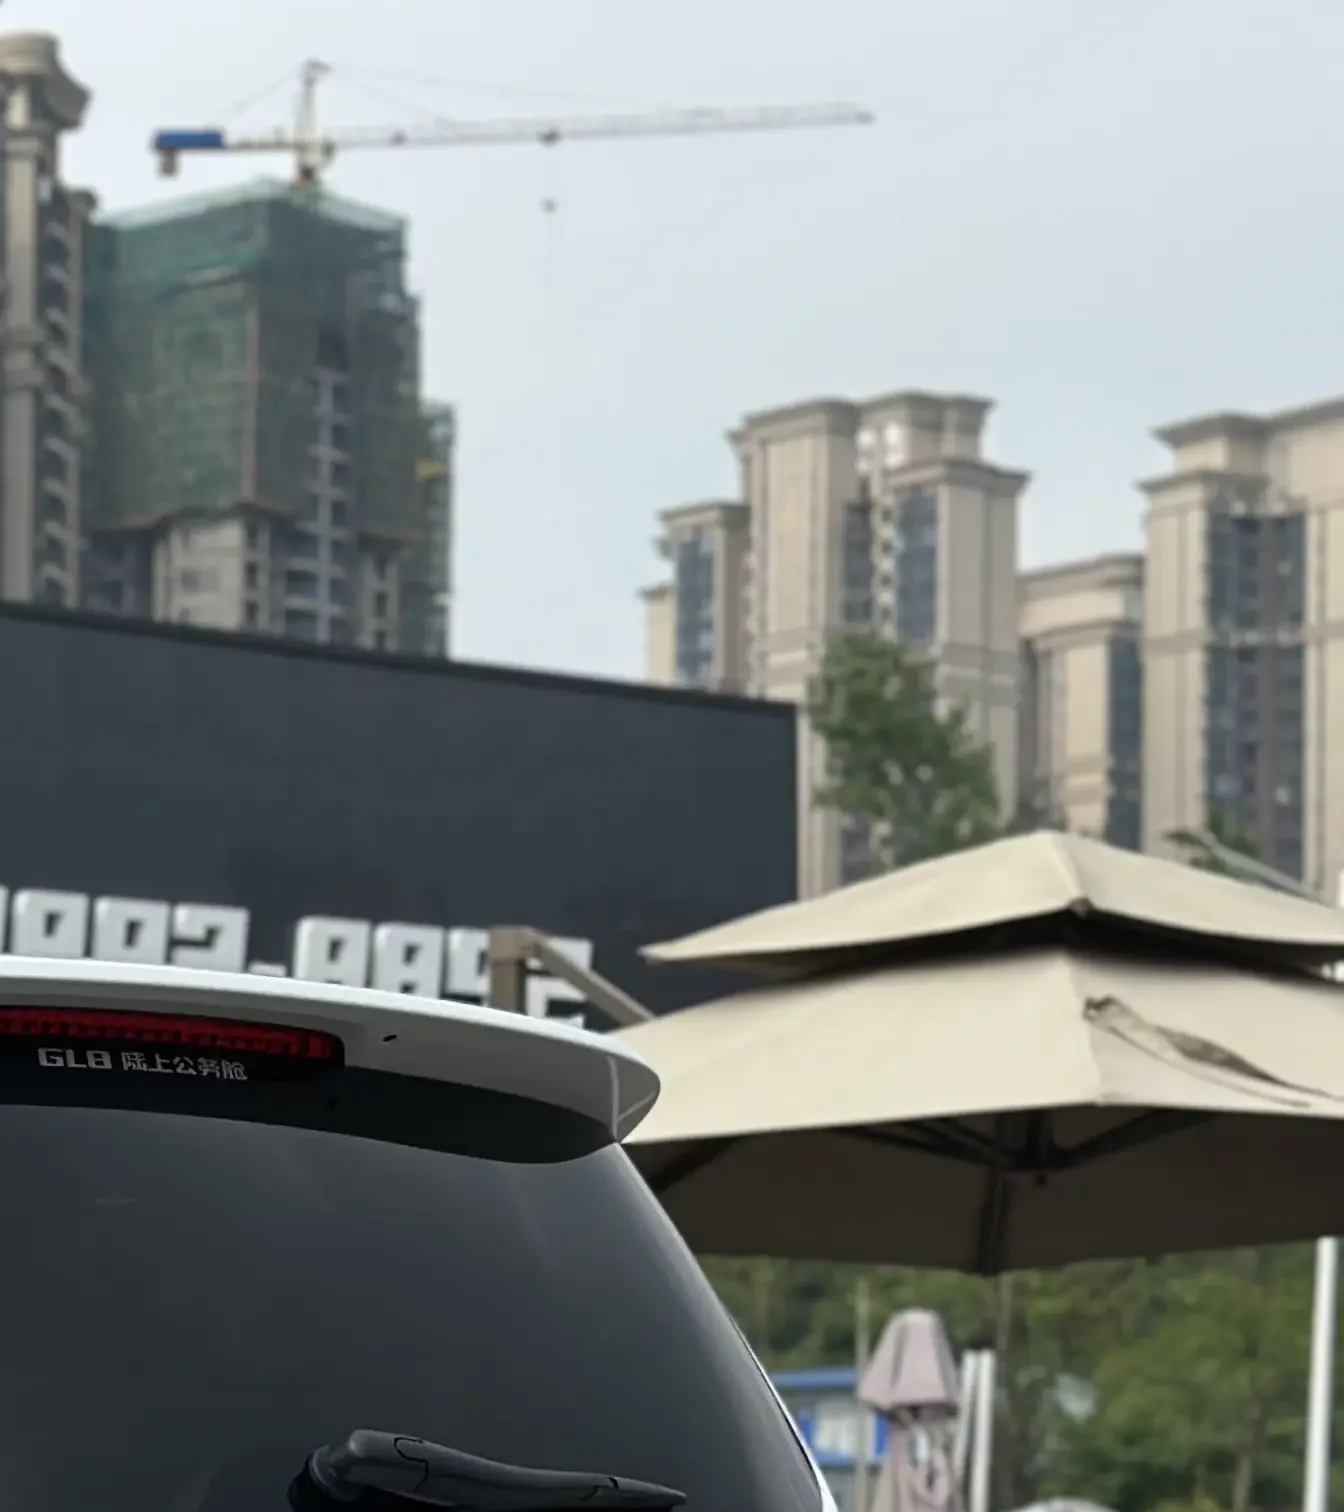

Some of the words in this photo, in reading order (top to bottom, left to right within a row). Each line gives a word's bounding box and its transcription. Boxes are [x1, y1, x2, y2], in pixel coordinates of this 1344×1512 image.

[38, 1047, 113, 1070] GL8
[121, 1051, 249, 1081] 陆上公务舱
